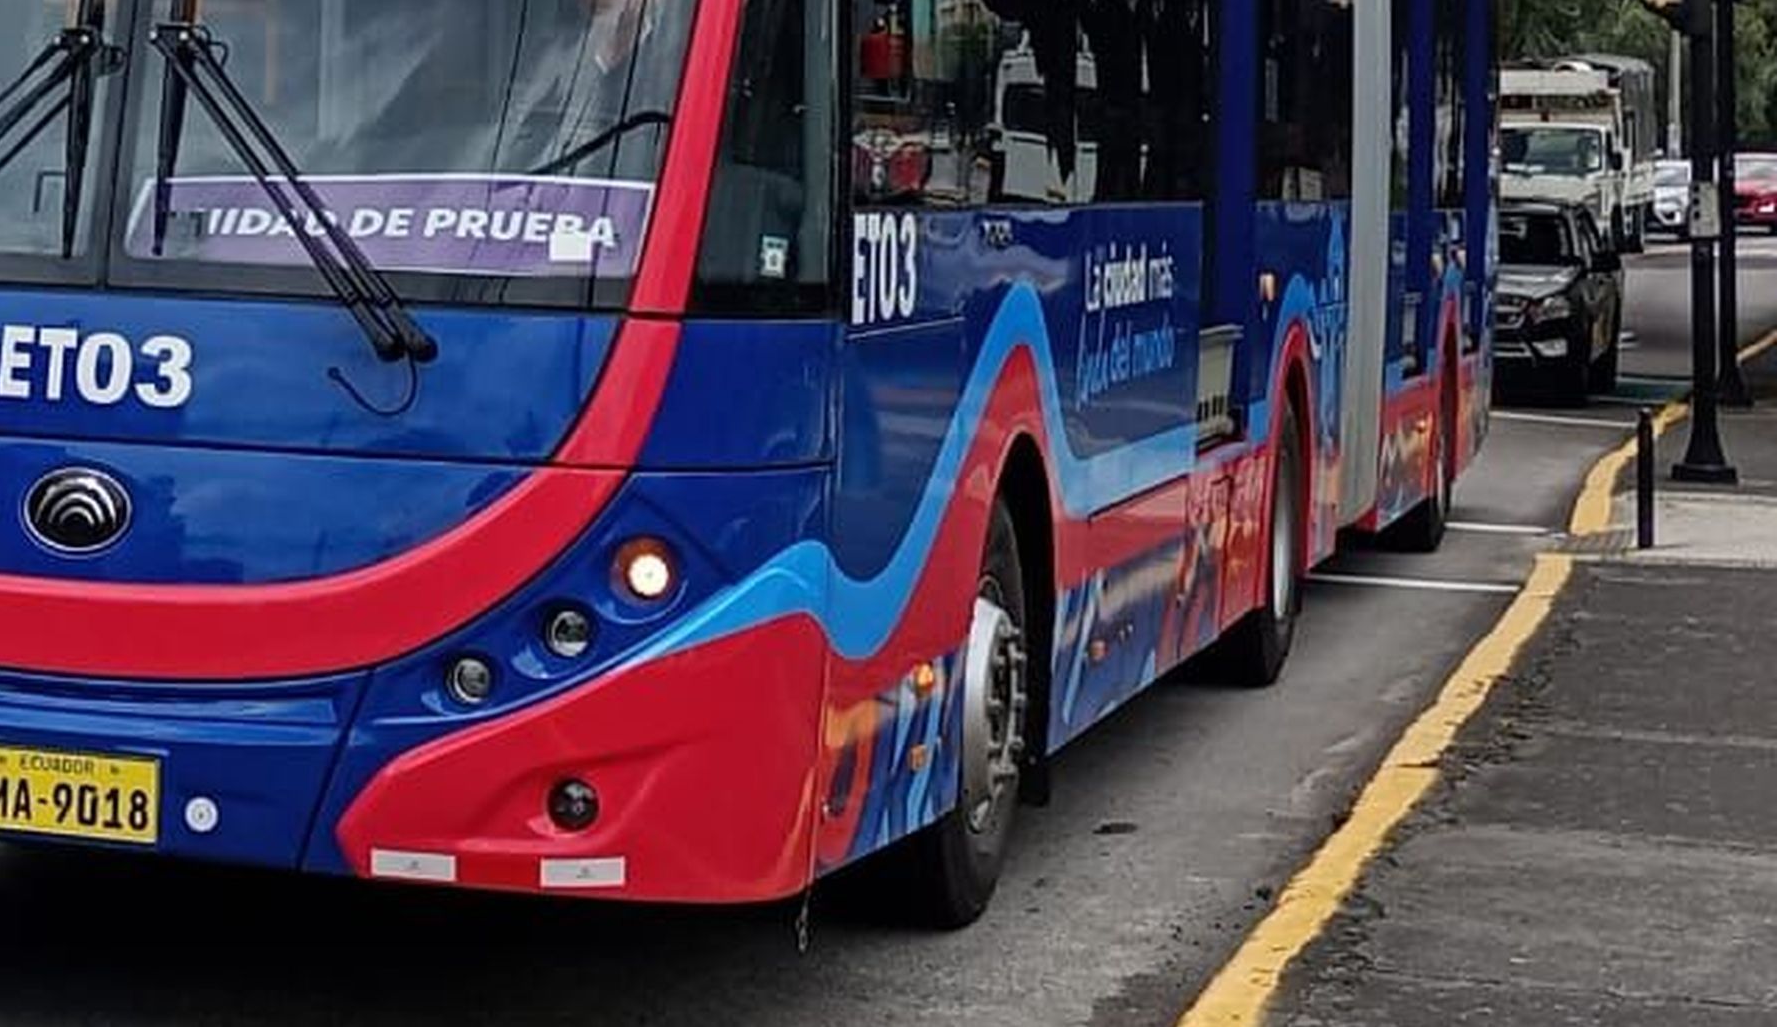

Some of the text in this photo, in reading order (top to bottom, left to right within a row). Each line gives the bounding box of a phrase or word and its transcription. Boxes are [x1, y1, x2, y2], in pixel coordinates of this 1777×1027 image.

[350, 207, 414, 238] DE
[852, 212, 916, 324] ET03
[1085, 250, 1100, 313] La
[1104, 240, 1146, 309] ciudad
[20, 755, 96, 775] ECUADOR
